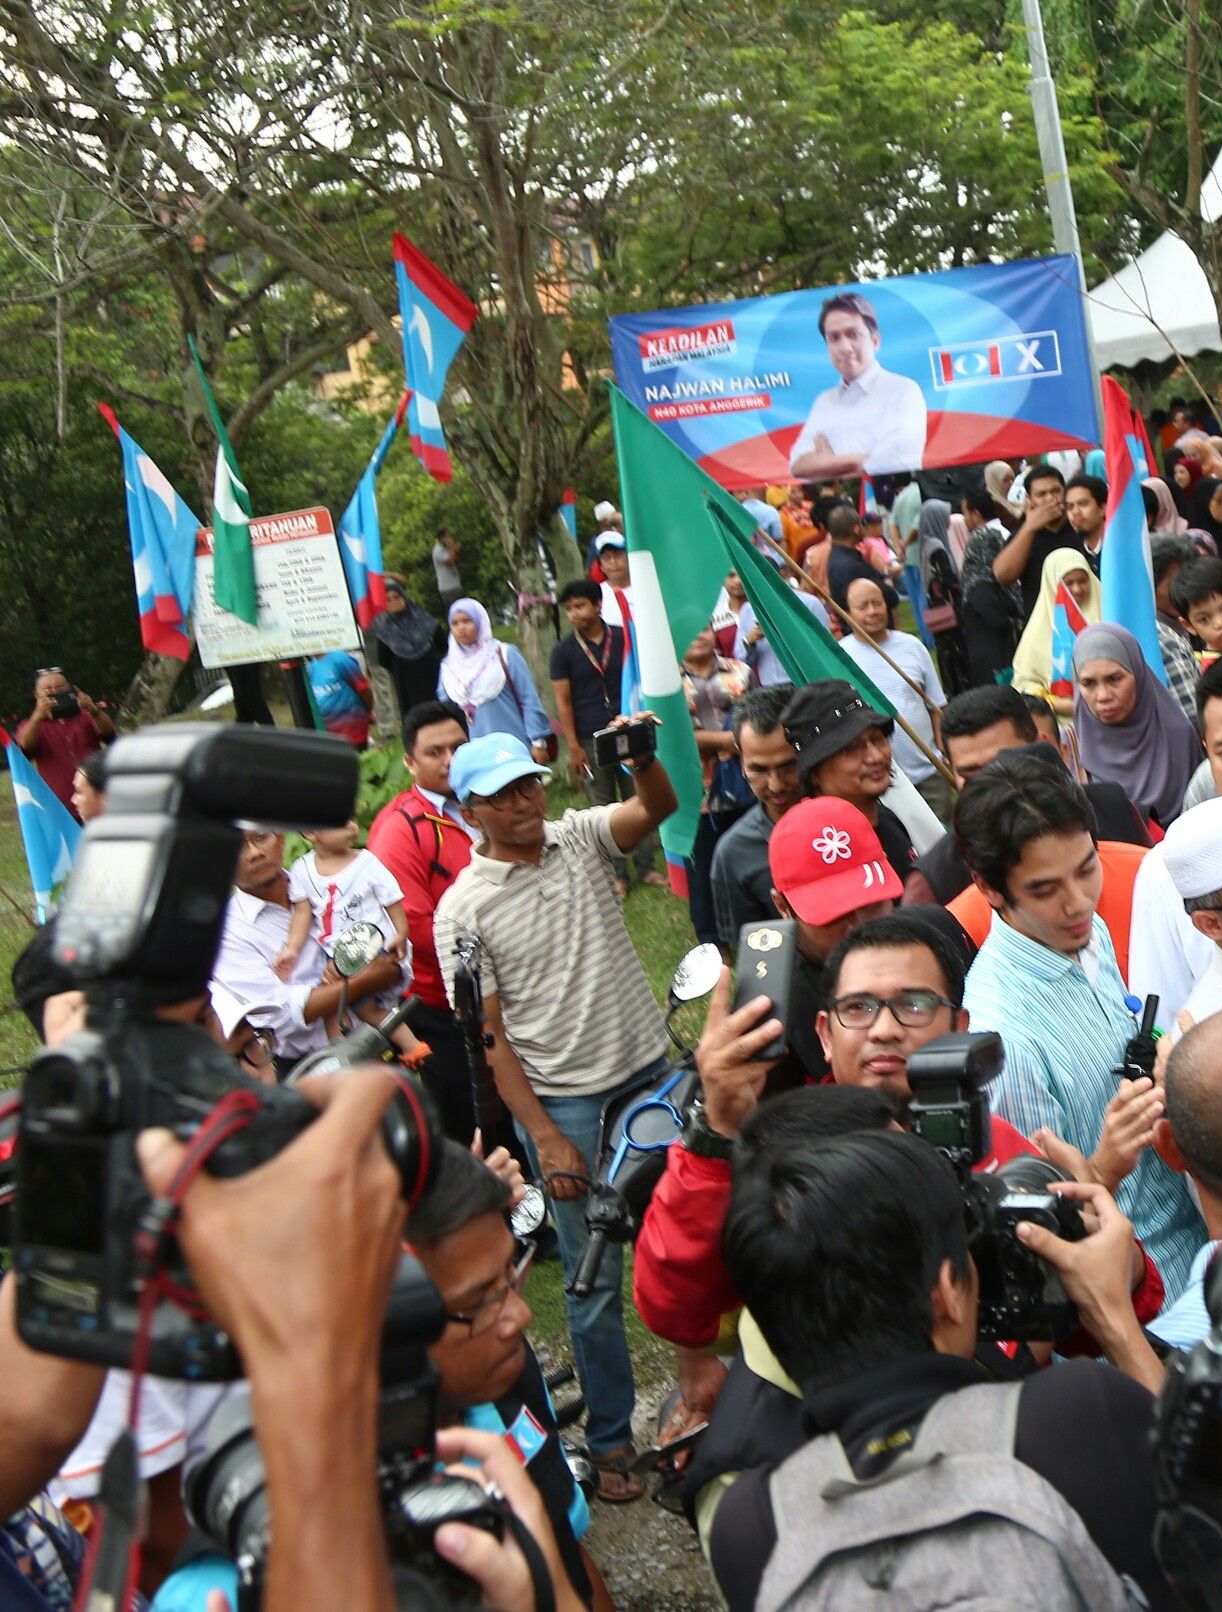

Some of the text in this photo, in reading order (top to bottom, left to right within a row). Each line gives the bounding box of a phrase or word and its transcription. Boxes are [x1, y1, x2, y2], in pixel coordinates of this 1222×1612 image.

[647, 324, 729, 357] KEADILAN
[644, 371, 791, 402] NAJWAN HALIMI
[679, 402, 708, 416] KOTA
[709, 396, 766, 412] ANGGERIK
